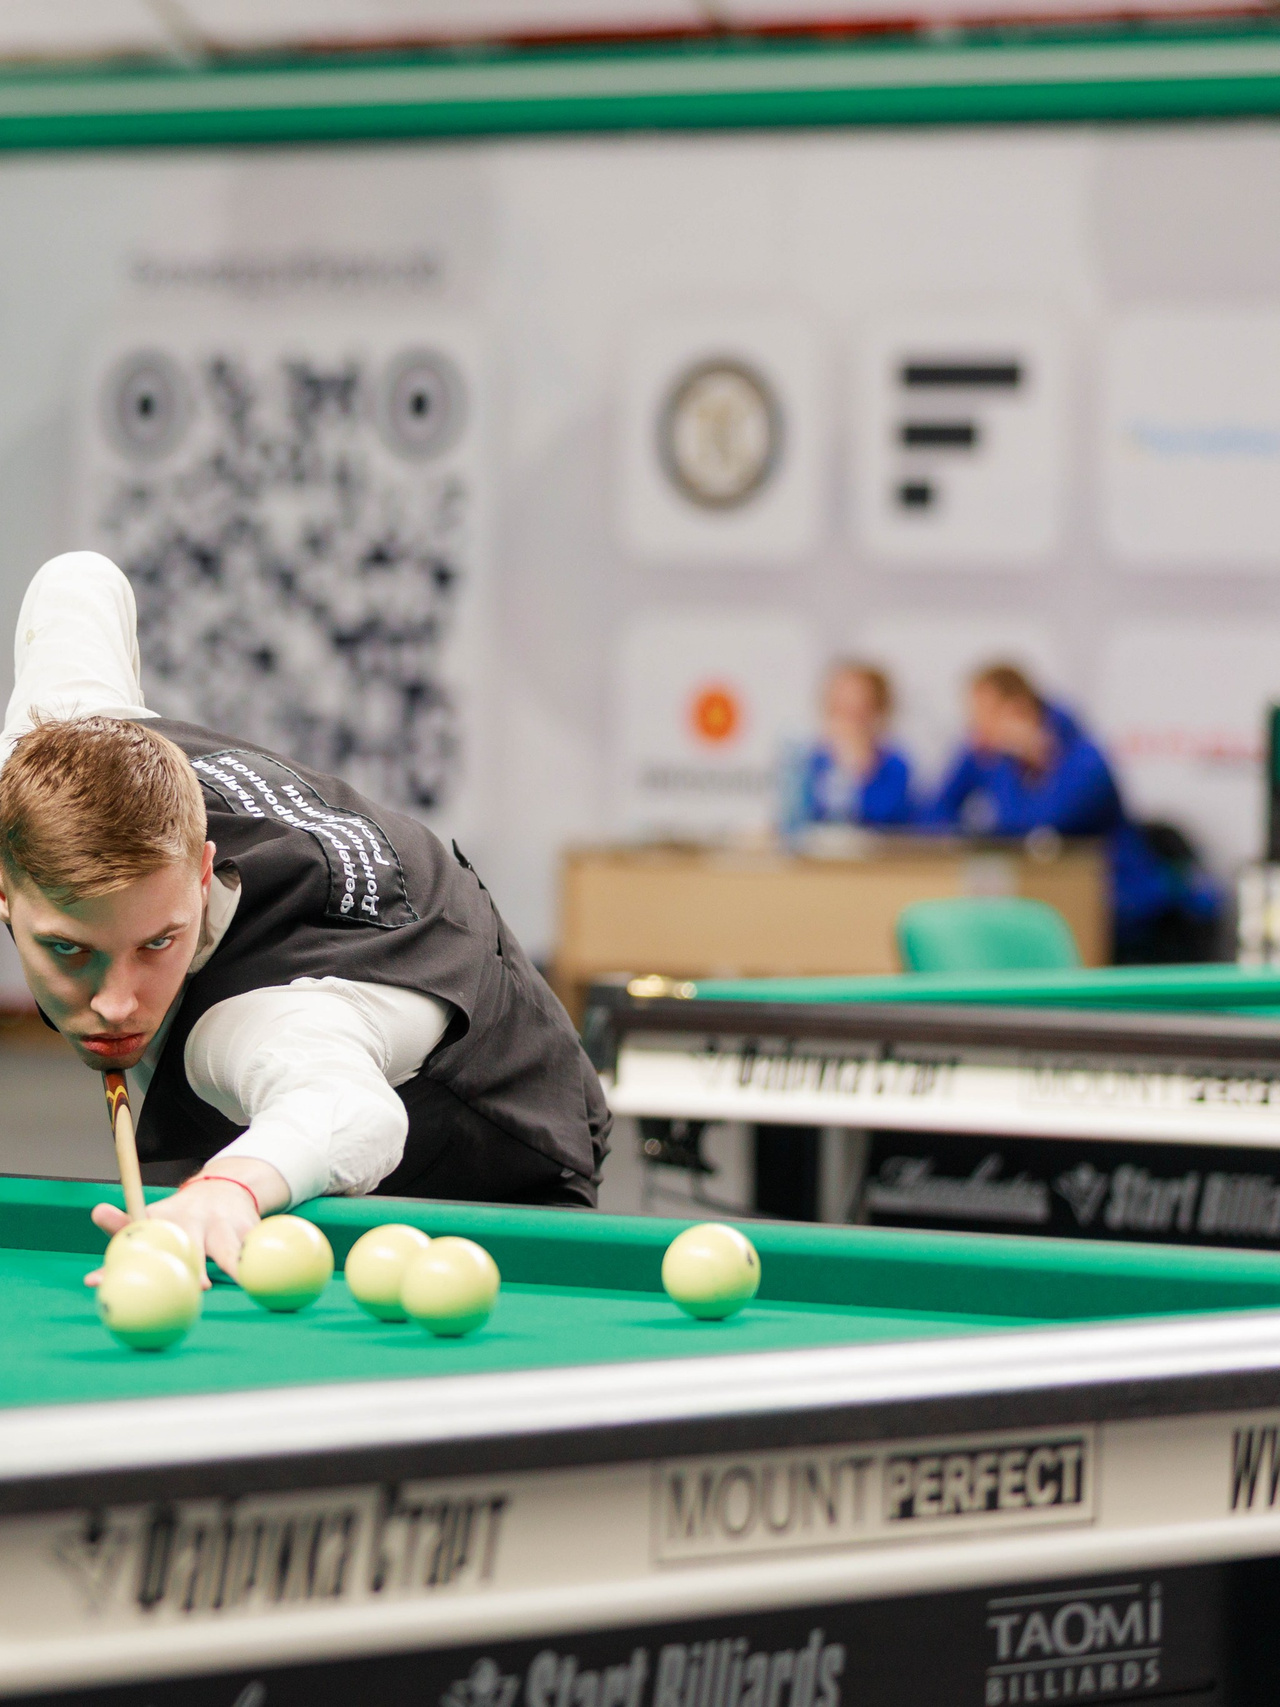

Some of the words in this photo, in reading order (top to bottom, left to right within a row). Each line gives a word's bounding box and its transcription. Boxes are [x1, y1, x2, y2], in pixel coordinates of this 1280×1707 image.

[666, 1455, 878, 1541] MOUNT
[886, 1441, 1084, 1520] PERFECT
[985, 1657, 1161, 1706] BILLIARDS
